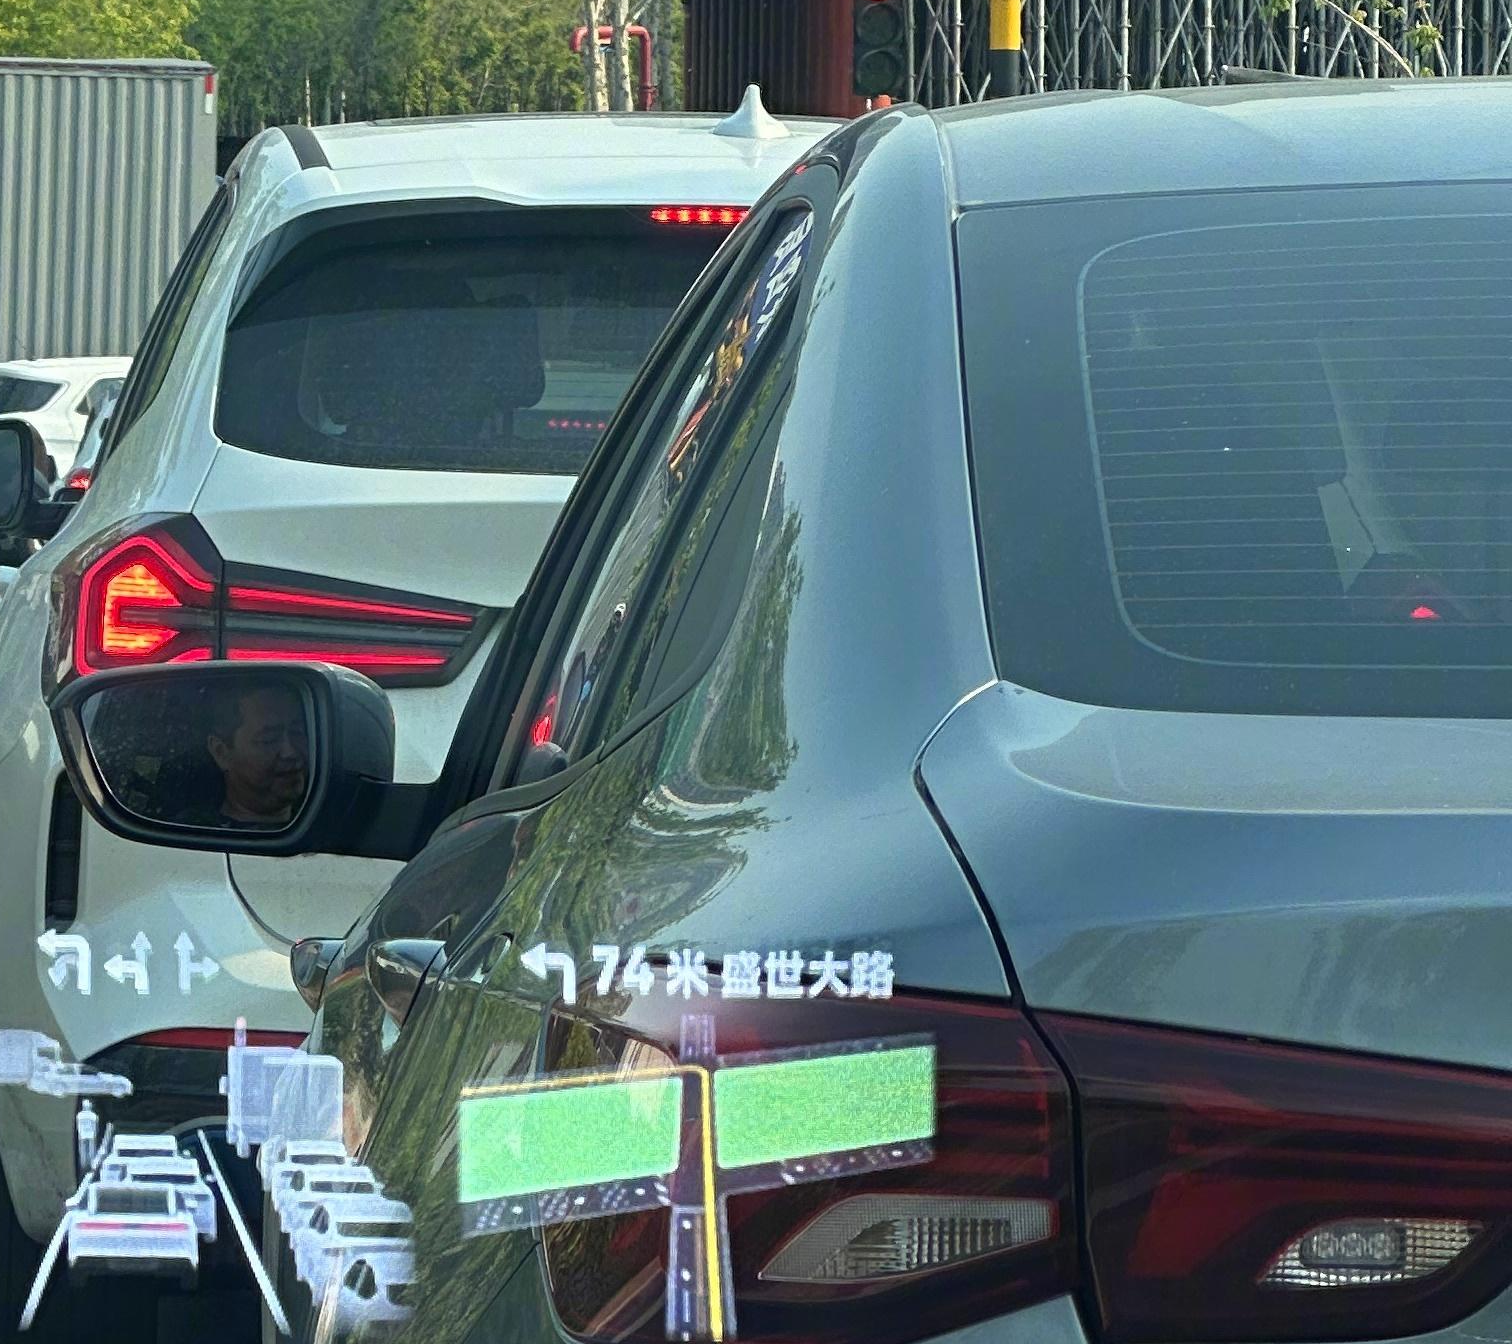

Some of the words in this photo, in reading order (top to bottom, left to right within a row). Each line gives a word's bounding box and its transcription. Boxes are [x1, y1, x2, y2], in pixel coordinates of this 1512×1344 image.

[591, 945, 656, 997] 74
[666, 947, 710, 1000] 米
[720, 949, 897, 1000] 盛世大路
